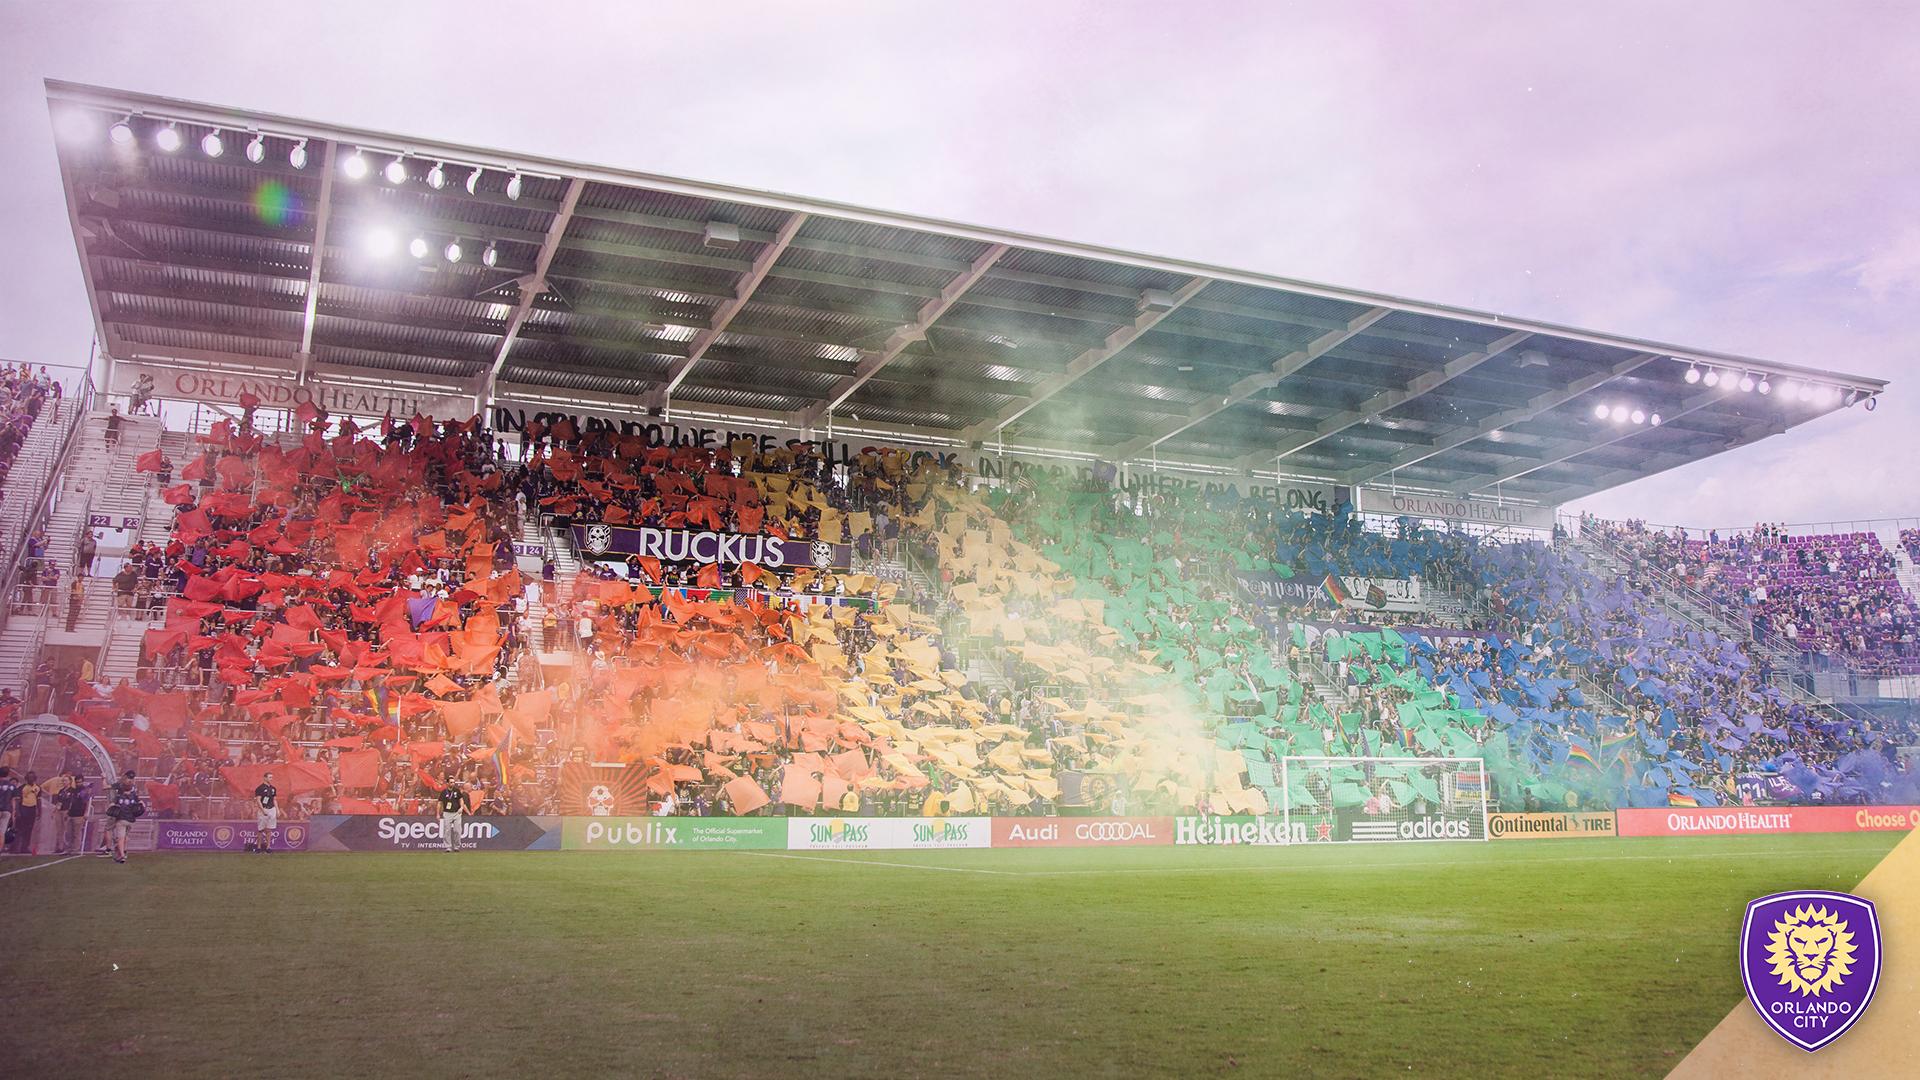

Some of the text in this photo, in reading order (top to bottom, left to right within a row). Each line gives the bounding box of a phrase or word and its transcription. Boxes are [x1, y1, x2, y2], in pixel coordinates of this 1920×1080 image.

[175, 373, 419, 416] ORLANDO HEALTH
[496, 407, 526, 432] IN
[1393, 496, 1523, 523] ORLANDO HEALTH
[94, 516, 106, 525] 22
[127, 518, 139, 527] 23
[529, 546, 540, 555] 24
[639, 527, 785, 568] RUCKUS
[1400, 816, 1470, 839] adidas
[1489, 815, 1611, 838] Continental TIRE
[1667, 812, 1790, 831] ORLANDO HEALTH
[1856, 808, 1907, 828] Choose
[166, 830, 207, 838] ORLANDO
[378, 817, 492, 843] Specum
[586, 822, 677, 844] Publix
[810, 823, 868, 842] SUN PASS
[913, 823, 968, 842] SUN PASS
[1009, 824, 1058, 840] Audi
[1175, 816, 1309, 845] Heineken
